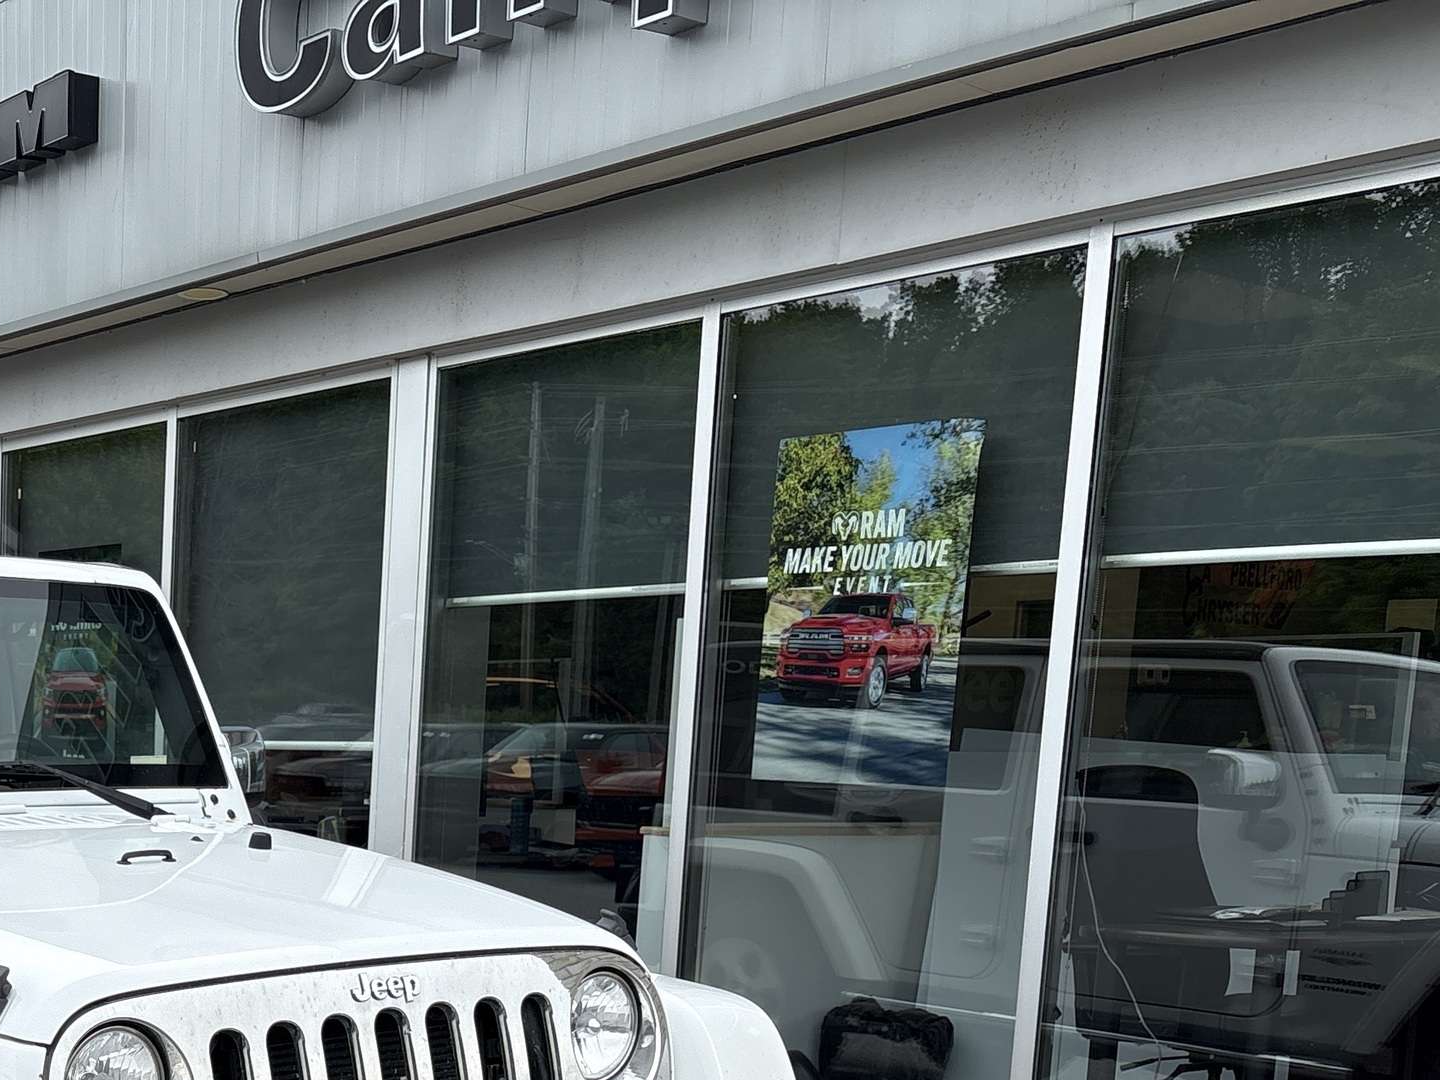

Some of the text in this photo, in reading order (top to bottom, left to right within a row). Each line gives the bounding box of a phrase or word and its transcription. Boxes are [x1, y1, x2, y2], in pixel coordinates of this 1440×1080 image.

[859, 508, 906, 538] RAM
[784, 539, 953, 575] MAKE YOUR MOVE
[833, 577, 893, 596] EVENT
[349, 971, 422, 1003] Jeep
